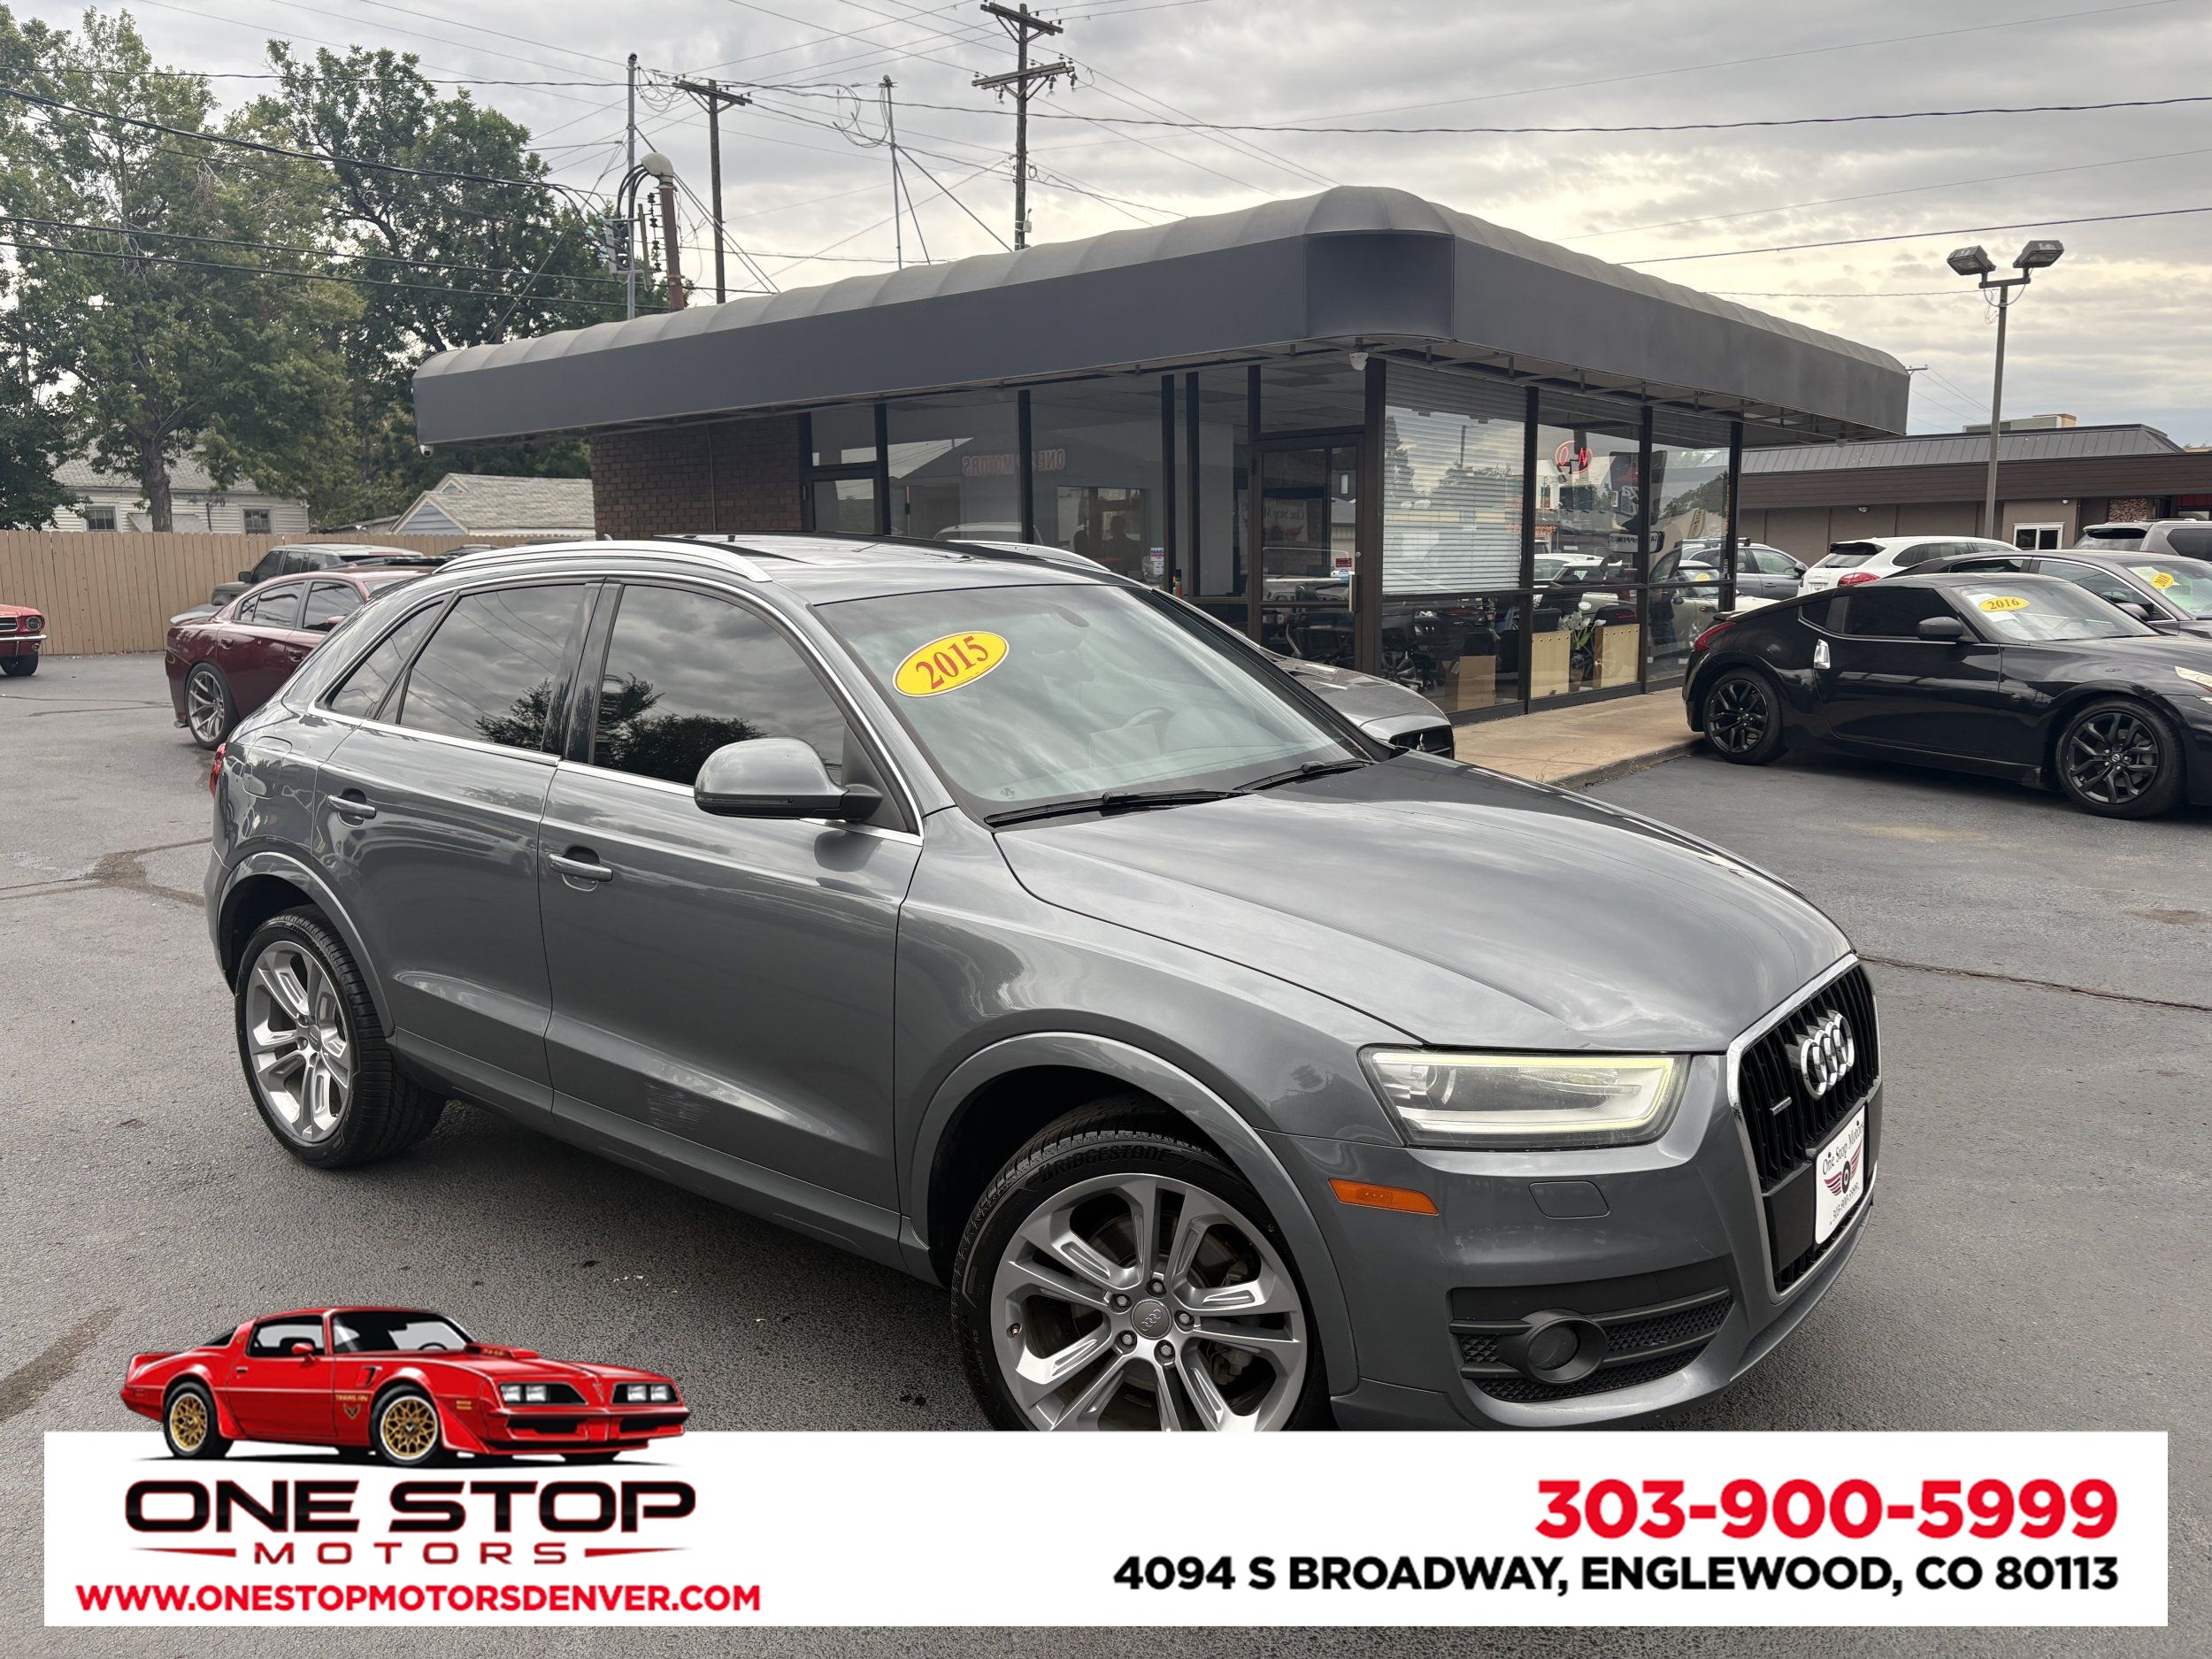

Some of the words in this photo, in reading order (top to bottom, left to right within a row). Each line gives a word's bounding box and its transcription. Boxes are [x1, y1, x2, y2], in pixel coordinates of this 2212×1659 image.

[1987, 598, 2020, 610] 2016
[915, 635, 988, 689] 2015
[1823, 1156, 1835, 1175] One
[1836, 1142, 1847, 1163] Stop
